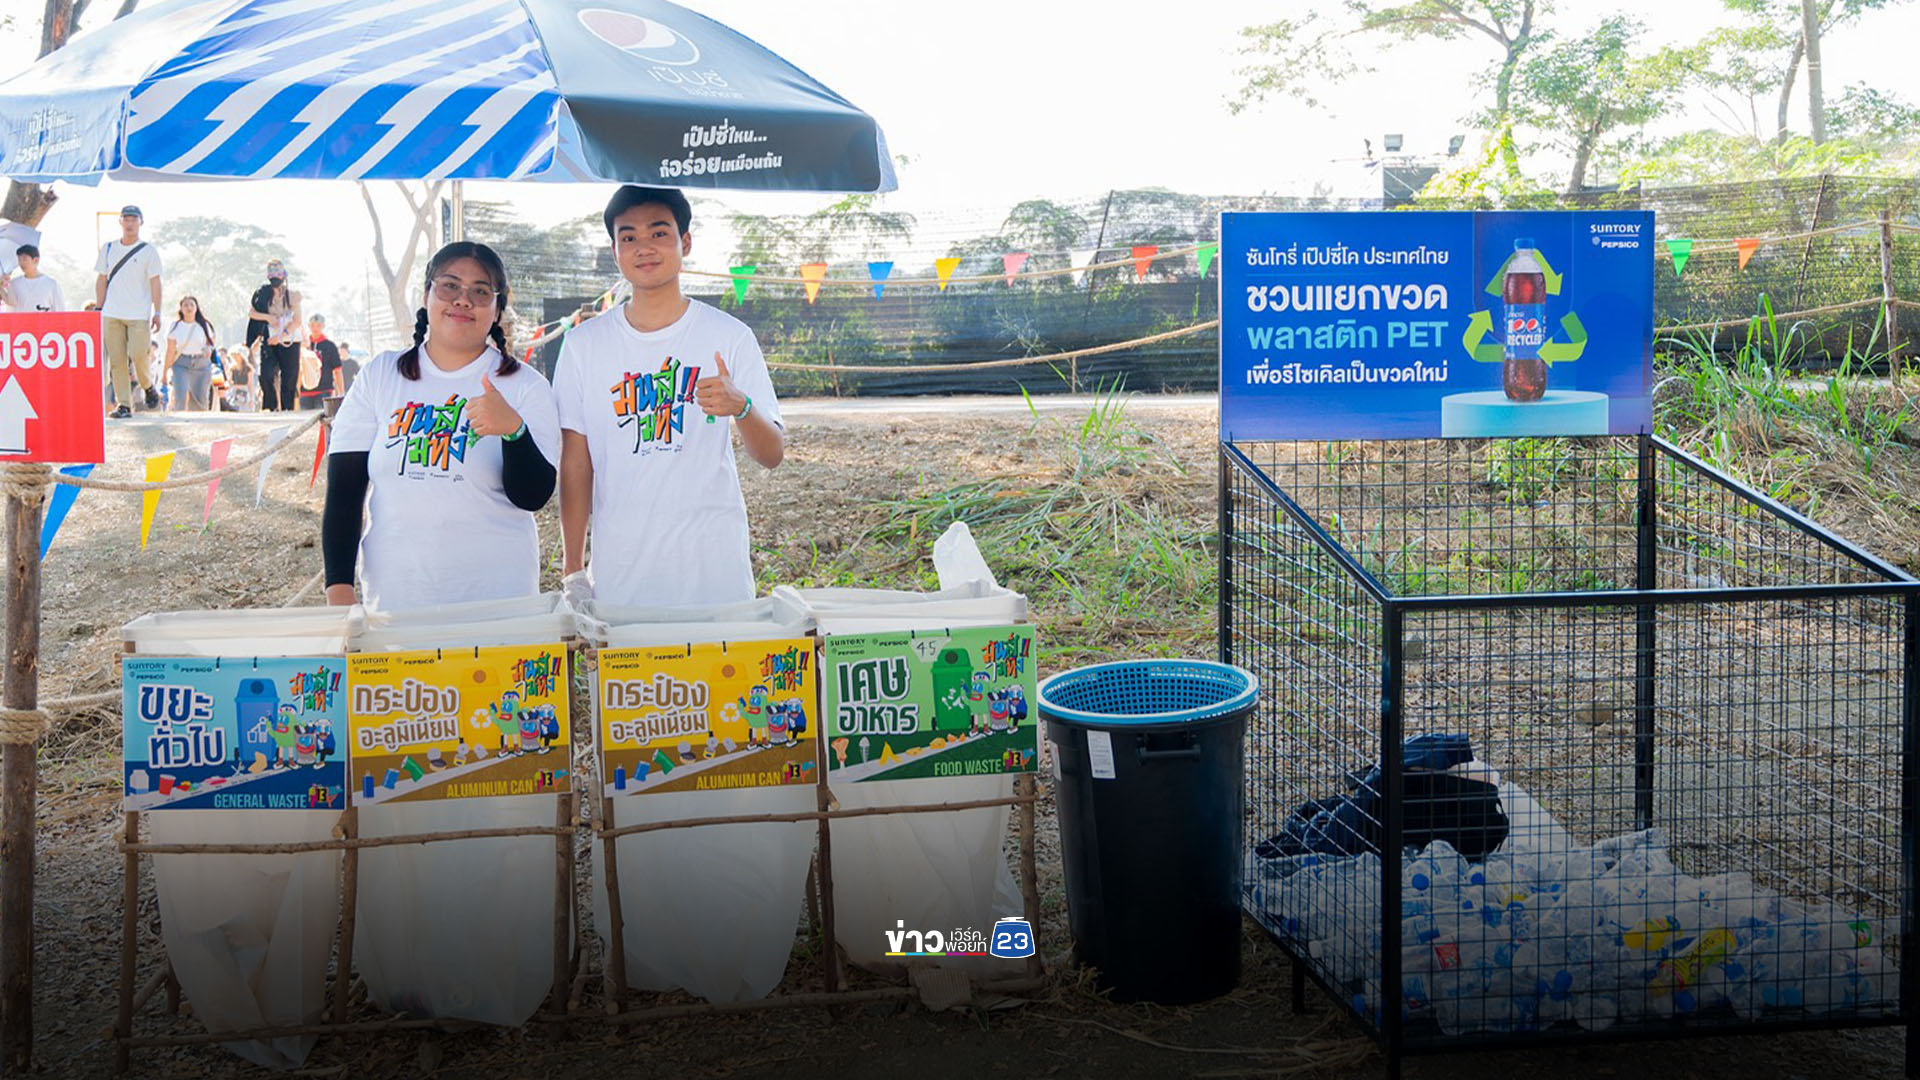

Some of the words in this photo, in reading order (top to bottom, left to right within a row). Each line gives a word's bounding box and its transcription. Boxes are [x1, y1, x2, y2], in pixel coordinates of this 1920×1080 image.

[659, 151, 783, 178] ก็อร่อยเหมือนกัน
[1590, 224, 1641, 233] SUNTORY
[1246, 242, 1297, 266] ซันโทรี่
[1302, 242, 1359, 266] เป๊ปซี่โค
[1364, 246, 1449, 265] ประเทศไทย
[1246, 284, 1448, 312] ชวนแยกขวด
[1246, 319, 1378, 350] พลาสติก
[1387, 321, 1449, 348] PET
[1246, 357, 1448, 384] เพื่อรีไซเคิลเป็นขวดใหม่
[606, 674, 708, 709] กระป๋อง
[838, 658, 908, 702] เศษ
[140, 685, 211, 722] ขยะ
[354, 679, 459, 714] กระป๋อง
[612, 711, 706, 744] อะลูมิเนียม
[838, 705, 917, 732] อาหาร
[150, 720, 224, 766] ทั่วไป
[360, 716, 457, 749] อะลูมิเนียม
[696, 773, 756, 790] ALUMINUM
[759, 771, 781, 786] CAN
[934, 761, 962, 776] FOOD
[965, 759, 1001, 774] WASTE
[214, 794, 266, 808] GENERAL
[269, 794, 307, 808] WASTE
[447, 780, 508, 798] ALUMINUM
[511, 780, 533, 794] CAN
